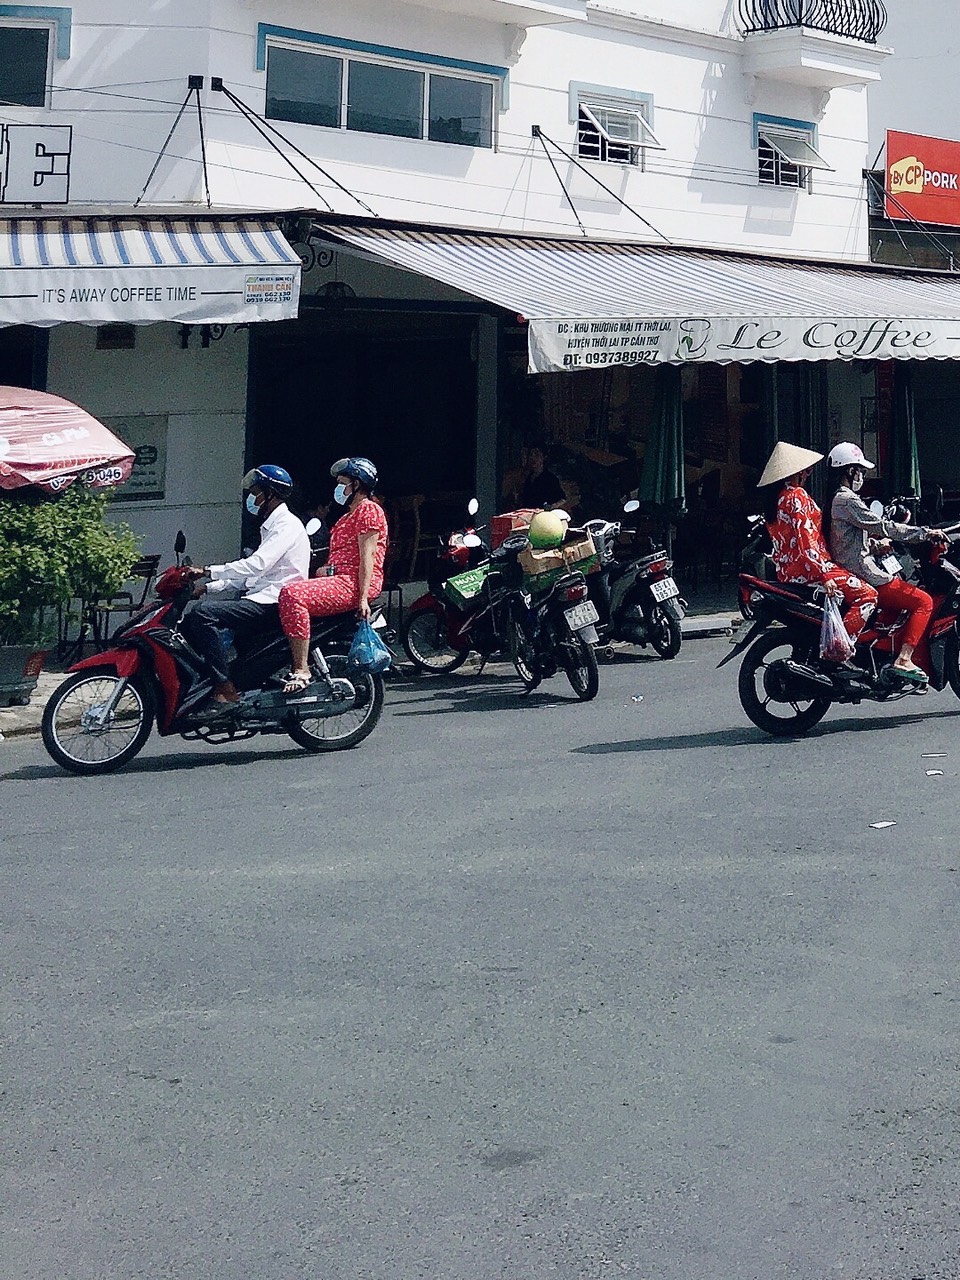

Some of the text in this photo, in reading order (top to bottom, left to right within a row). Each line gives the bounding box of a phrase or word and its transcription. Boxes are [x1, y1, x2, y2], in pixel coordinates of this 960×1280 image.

[892, 170, 904, 187] By
[905, 165, 921, 185] CP
[923, 170, 958, 190] PORK
[42, 286, 197, 303] IT'S AWAY COFFEE TIME
[573, 322, 590, 333] KHU
[608, 337, 619, 347] LAI
[620, 337, 630, 347] TP
[716, 320, 938, 357] Le Coffee
[585, 350, 660, 365] 0937389927
